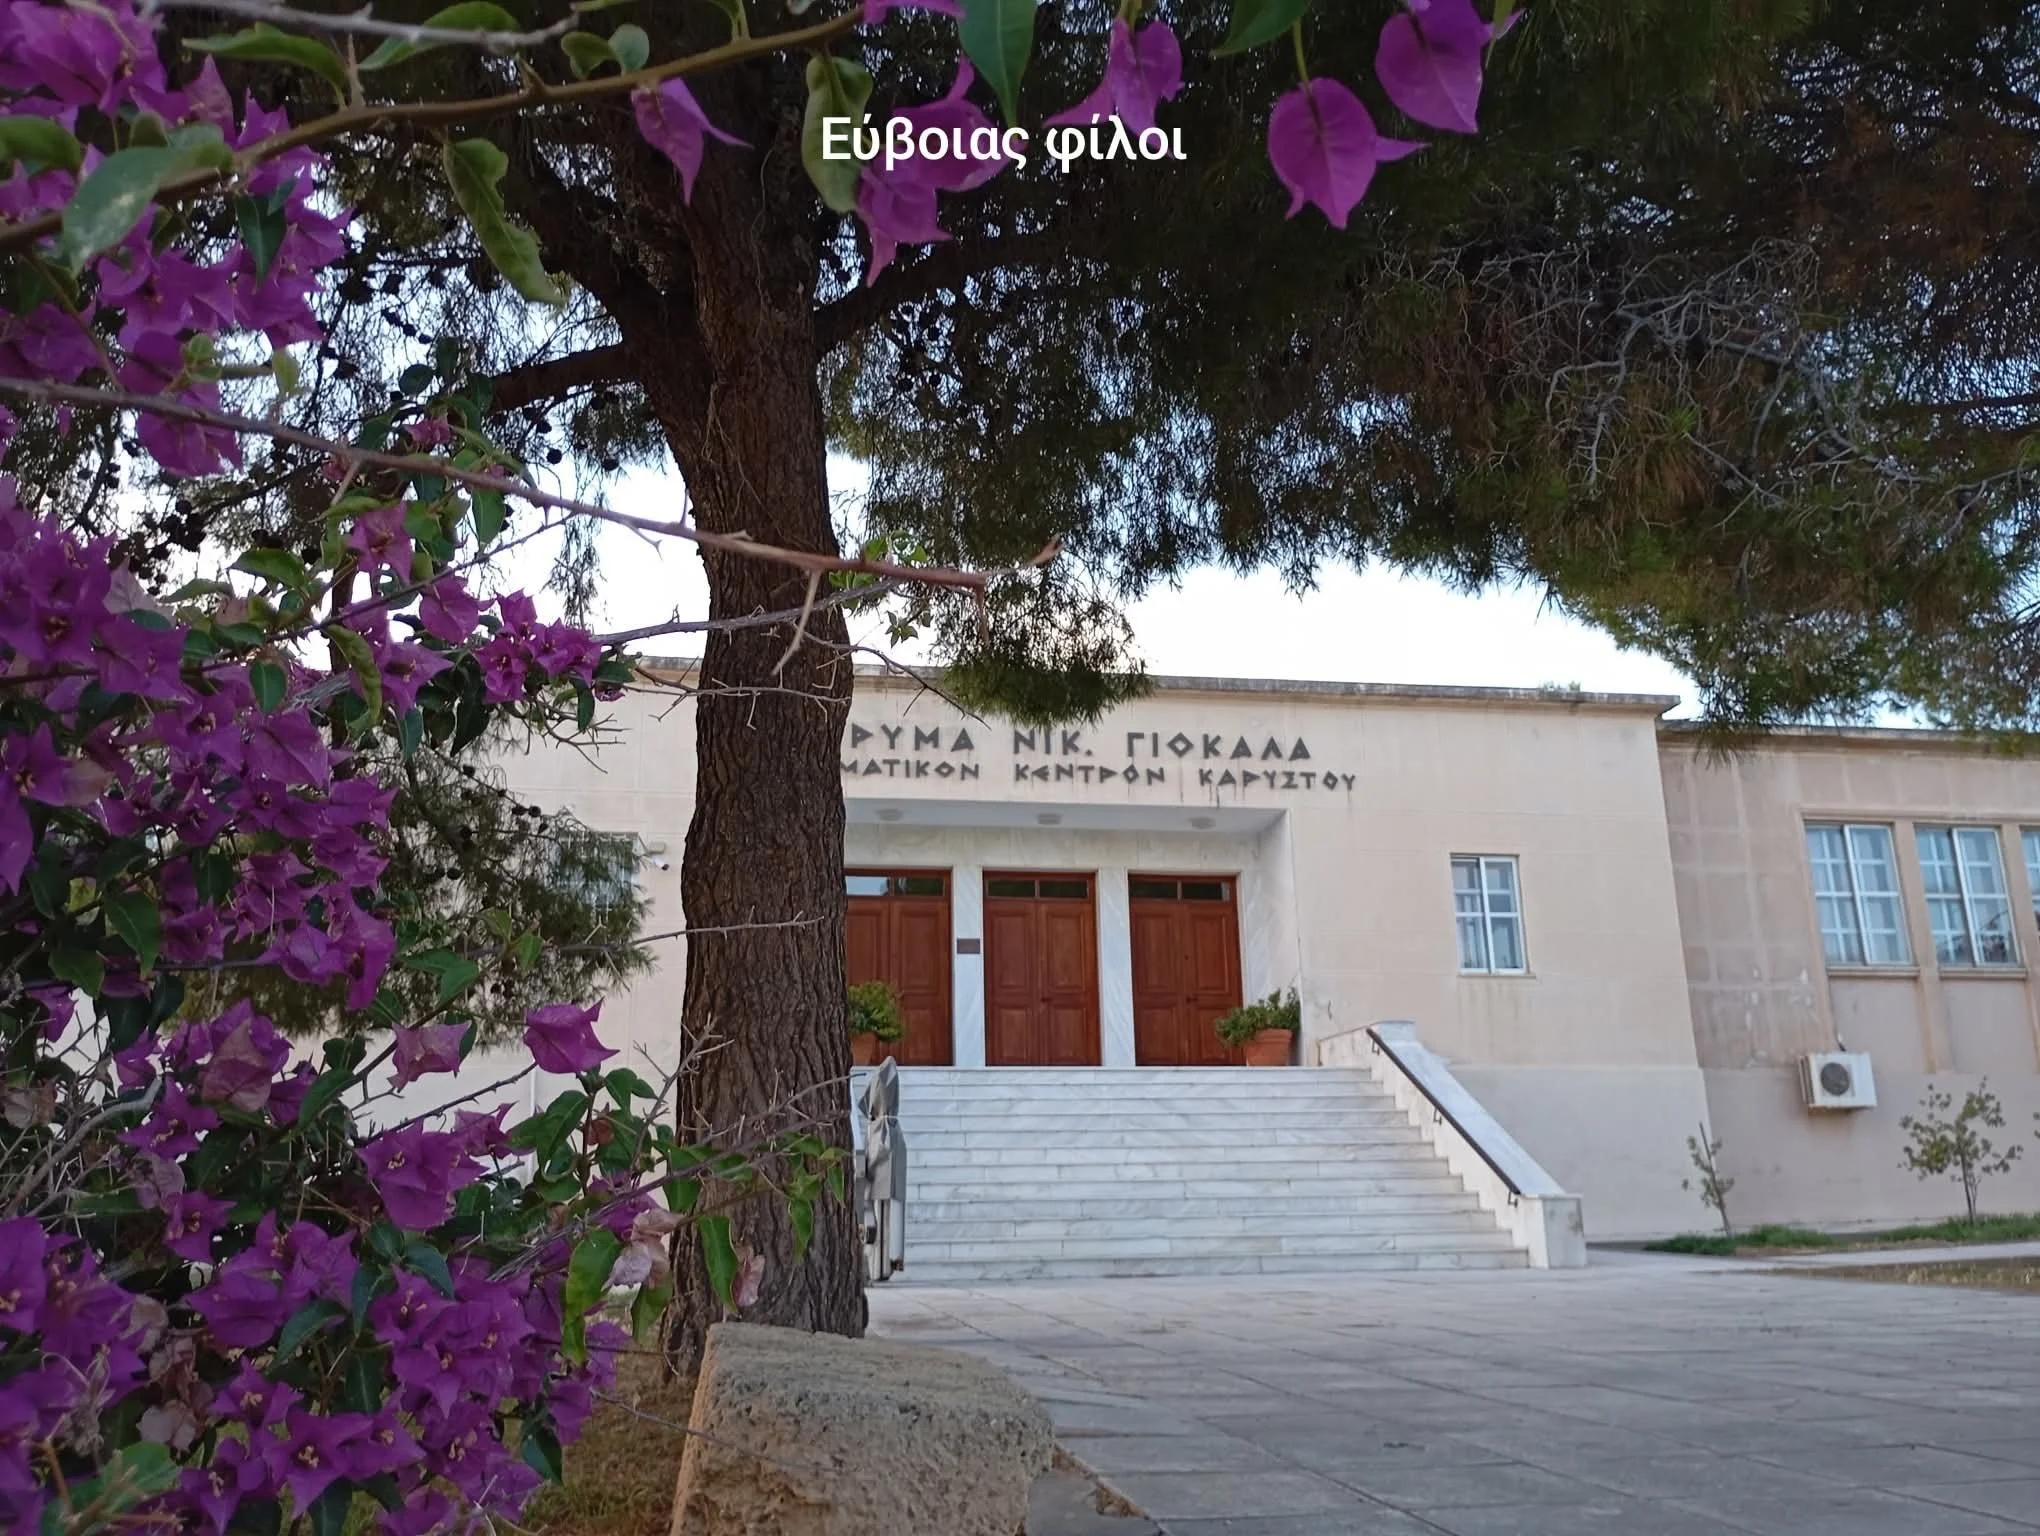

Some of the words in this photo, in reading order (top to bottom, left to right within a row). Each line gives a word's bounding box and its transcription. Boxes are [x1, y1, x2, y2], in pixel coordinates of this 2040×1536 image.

[851, 722, 975, 753] ΡΥΜΑ
[1013, 727, 1093, 757] ΝΙΚ.
[1127, 731, 1312, 762] ΓΙΟΚΑΛΑ
[840, 757, 980, 781] ΜΑΤΙΚΟΝ
[1015, 762, 1165, 786] ΚΕΝΤΡΟΝ
[1198, 767, 1357, 792] ΚΑΡΥΣΤΟΥ
